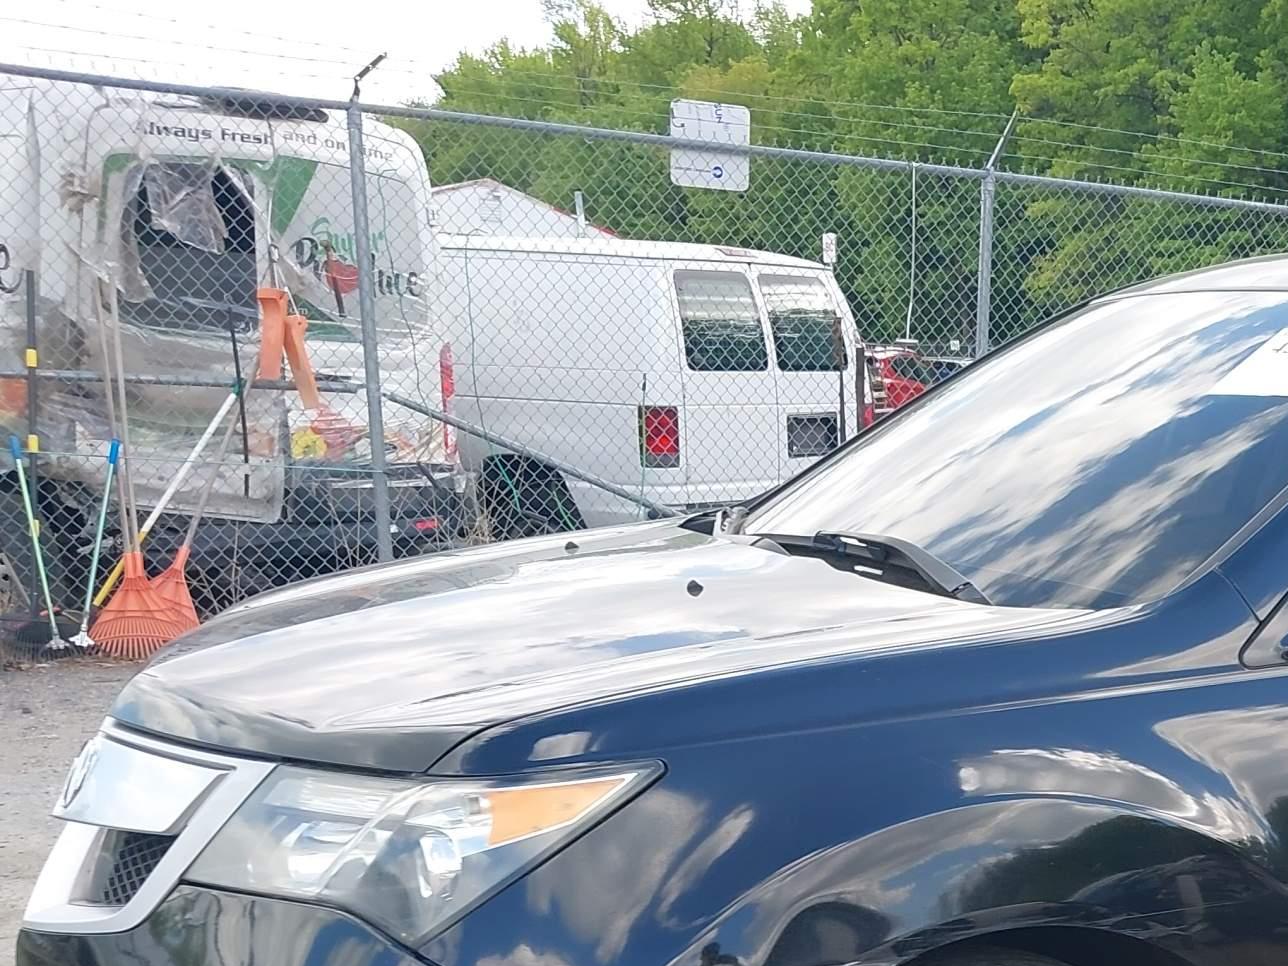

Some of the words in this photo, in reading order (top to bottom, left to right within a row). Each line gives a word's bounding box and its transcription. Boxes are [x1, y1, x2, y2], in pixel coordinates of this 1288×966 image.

[136, 120, 213, 142] Always
[221, 127, 273, 144] Fresh
[282, 131, 317, 145] and
[324, 138, 346, 151] on
[360, 144, 393, 161] ime
[311, 216, 385, 263] Supr
